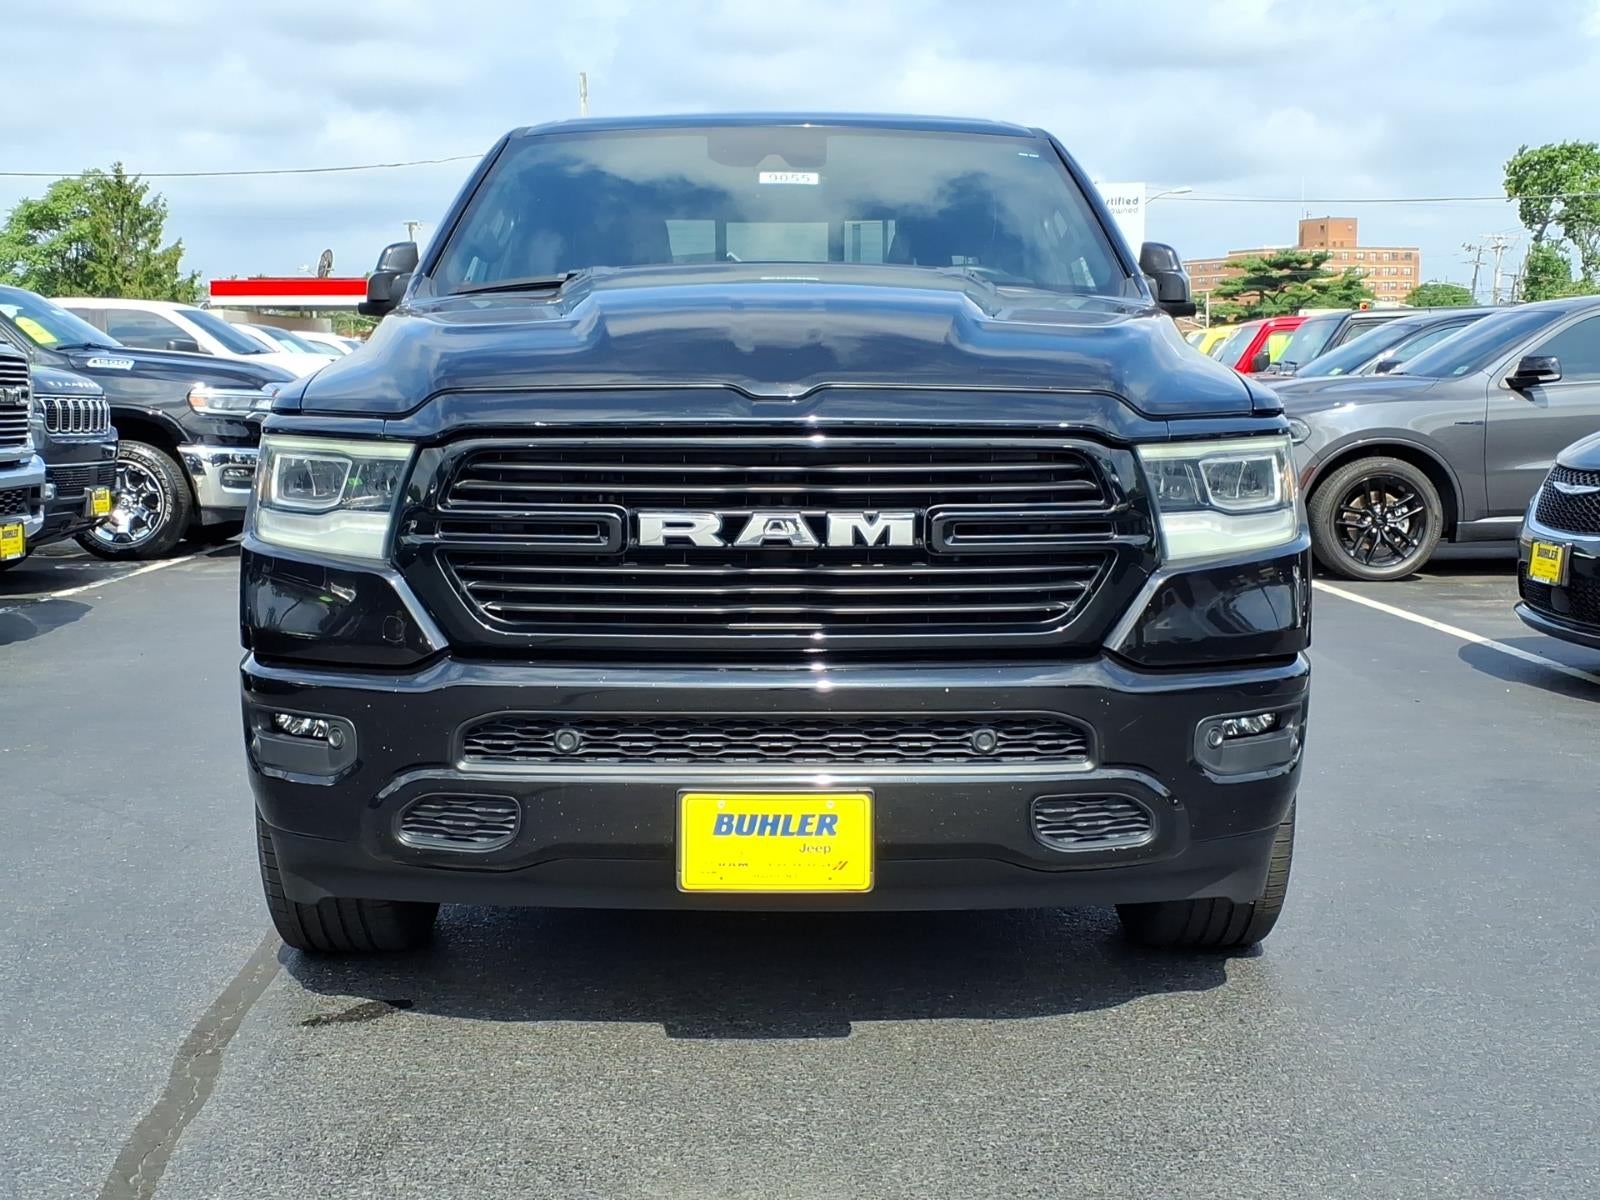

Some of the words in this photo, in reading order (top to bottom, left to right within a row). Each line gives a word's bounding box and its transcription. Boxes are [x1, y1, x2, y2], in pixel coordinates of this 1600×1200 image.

[638, 512, 915, 546] RAM
[713, 813, 839, 836] BUHLER
[799, 843, 831, 854] Jeep
